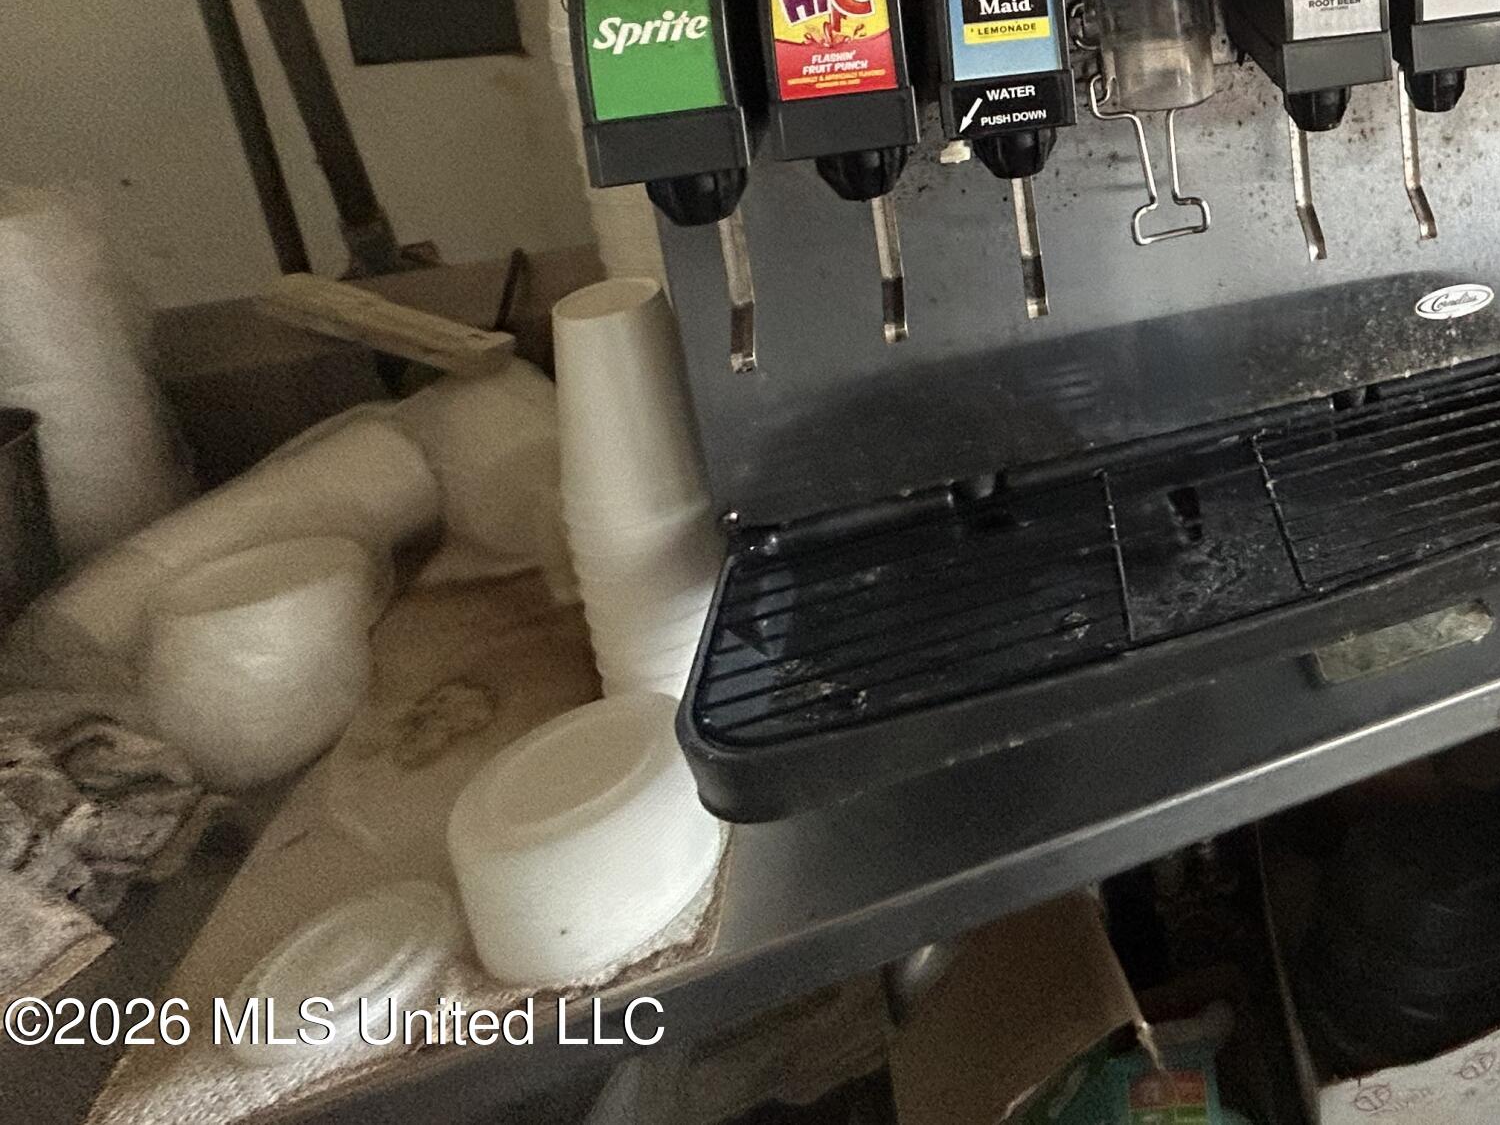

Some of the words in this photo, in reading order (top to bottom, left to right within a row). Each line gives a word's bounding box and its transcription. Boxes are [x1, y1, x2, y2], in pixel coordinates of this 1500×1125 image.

[592, 10, 709, 55] Sprite
[977, 22, 1038, 36] LEMONADE
[802, 62, 832, 76] FRUIT
[833, 59, 868, 72] PUNCH
[985, 84, 1036, 101] WATER
[980, 113, 1011, 126] PUSH
[1012, 109, 1047, 122] DOWN
